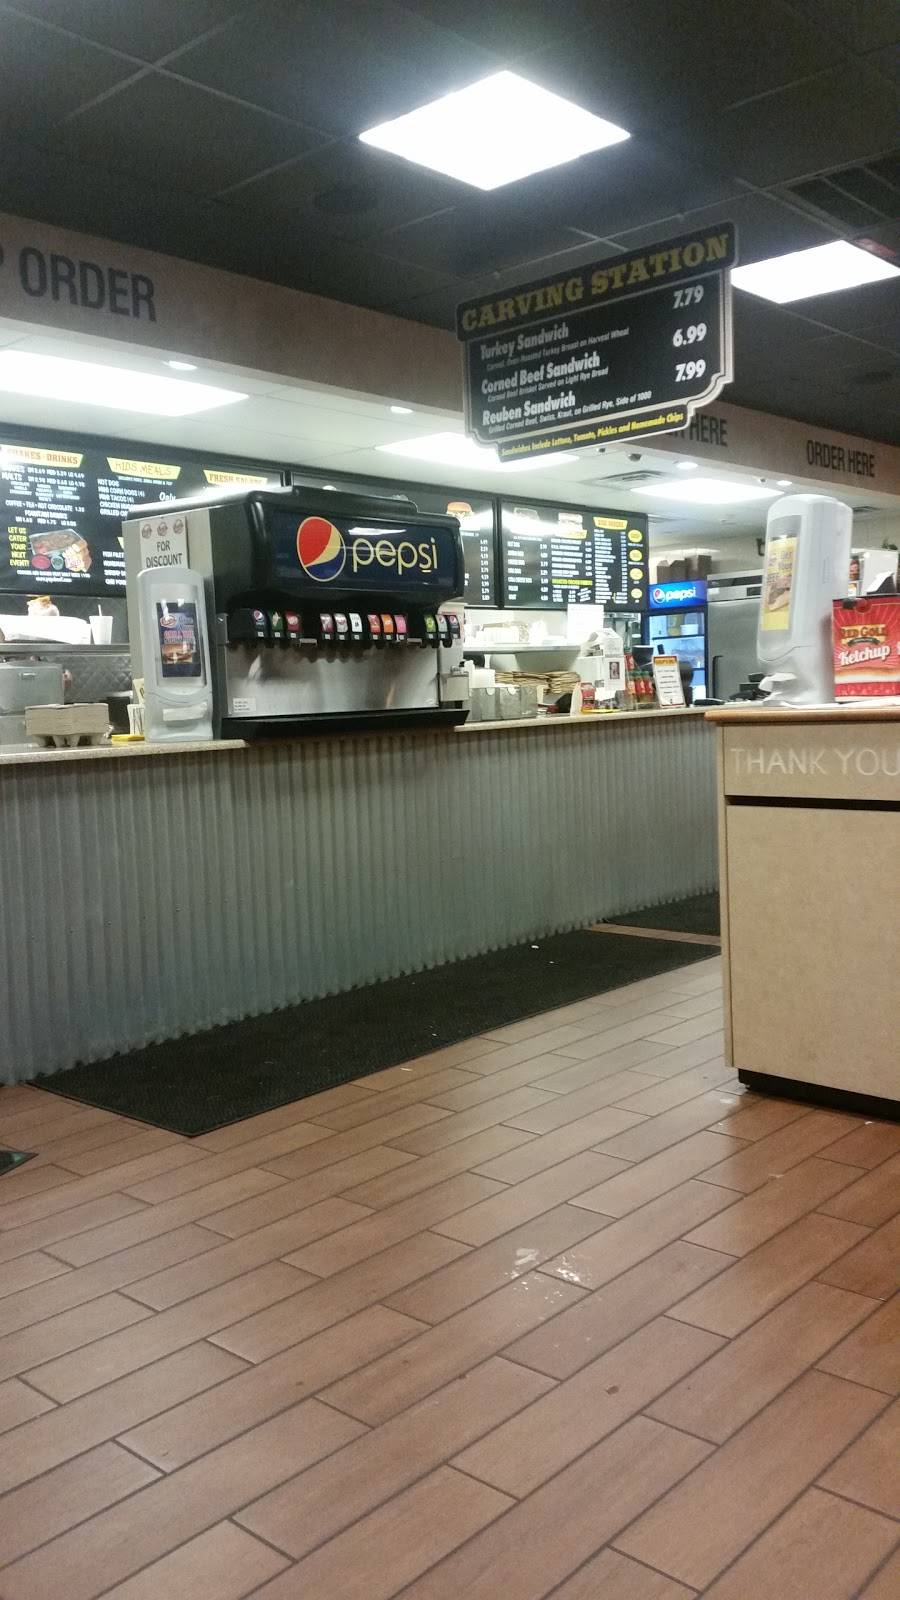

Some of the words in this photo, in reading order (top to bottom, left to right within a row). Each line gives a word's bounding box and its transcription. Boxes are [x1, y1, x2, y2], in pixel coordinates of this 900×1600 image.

[19, 246, 156, 322] ORDER
[461, 276, 586, 332] CARVING
[591, 233, 730, 295] STATION
[672, 284, 705, 309] 7.79
[480, 340, 516, 361] Turkey
[517, 322, 569, 351] Sandwich
[588, 332, 610, 344] Harvest
[610, 326, 630, 339] Wheat
[672, 322, 707, 347] 6.99
[481, 370, 519, 394] Corned
[519, 364, 545, 386] Beef
[546, 351, 600, 379] Sandwich
[537, 380, 557, 391] Served
[557, 378, 565, 387] on
[565, 374, 579, 384] Light
[579, 372, 591, 381] Rye
[591, 366, 609, 378] Bread
[674, 358, 707, 383] 7.99
[482, 406, 522, 426] Reuben
[523, 391, 576, 417] Sandwich
[582, 401, 602, 413] Grilled
[615, 396, 629, 406] Side
[629, 394, 637, 403] of
[597, 425, 617, 437] Pickles
[618, 421, 631, 432] and
[631, 415, 666, 430] Homemade
[666, 412, 684, 423] Chips
[689, 412, 729, 447] HERE
[46, 453, 78, 465] DRINKS
[806, 440, 846, 472] ORDER
[848, 448, 876, 478] HERE
[48, 503, 73, 512] CHOCOLATE
[8, 526, 17, 534] LET
[8, 535, 27, 543] CATER
[156, 540, 171, 552] FOR
[352, 537, 438, 575] pepsi
[145, 553, 183, 568] DISCOUNT
[665, 586, 696, 602] pepsi
[838, 645, 891, 666] Ketchup
[730, 748, 828, 776] THANK
[833, 748, 900, 777] YOU
